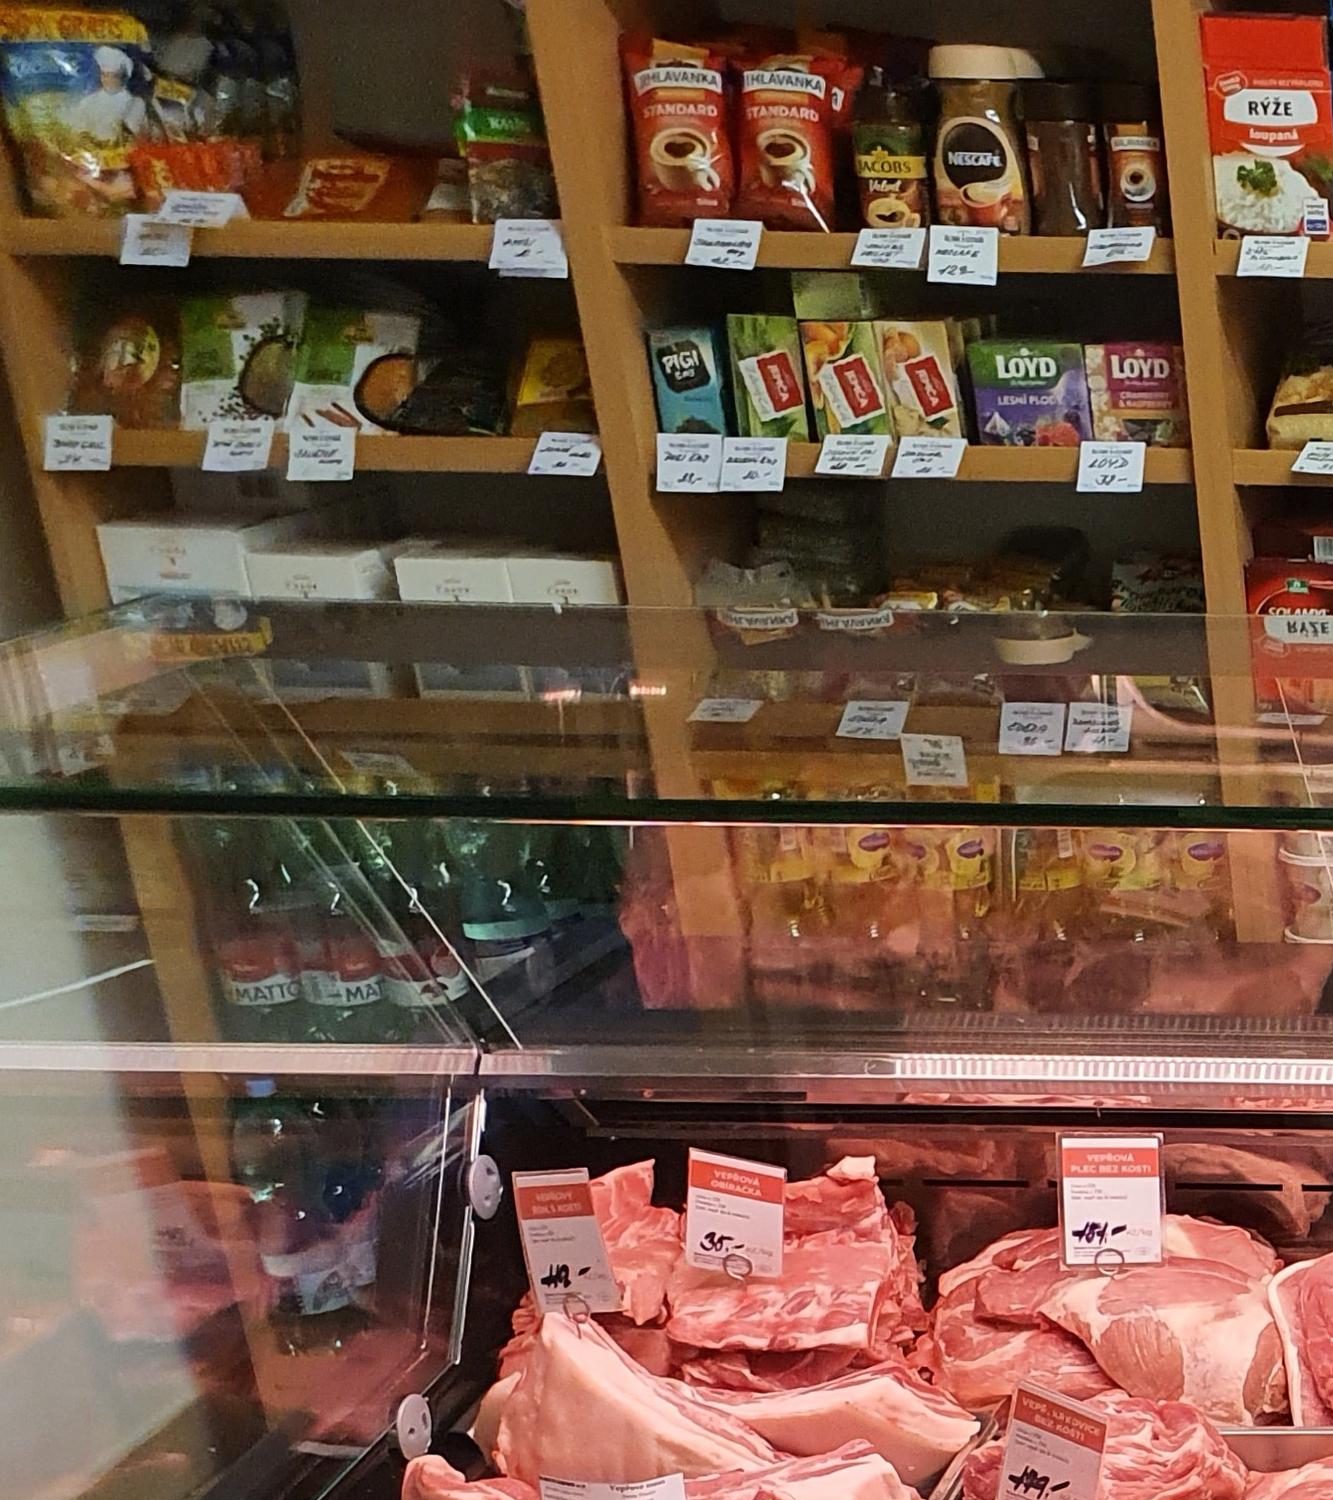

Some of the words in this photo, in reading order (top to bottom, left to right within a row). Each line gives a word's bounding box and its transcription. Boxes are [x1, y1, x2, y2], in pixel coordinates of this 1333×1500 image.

[1247, 96, 1293, 117] RÝŽE
[1248, 128, 1299, 144] loupaná
[994, 355, 1058, 380] LOYD
[1110, 354, 1170, 380] LOYD
[713, 1169, 760, 1187] VEPŘOVÁ
[1070, 1164, 1097, 1174] PLEC
[1099, 1164, 1120, 1174] BEZ
[1121, 1164, 1153, 1174] KOSTI
